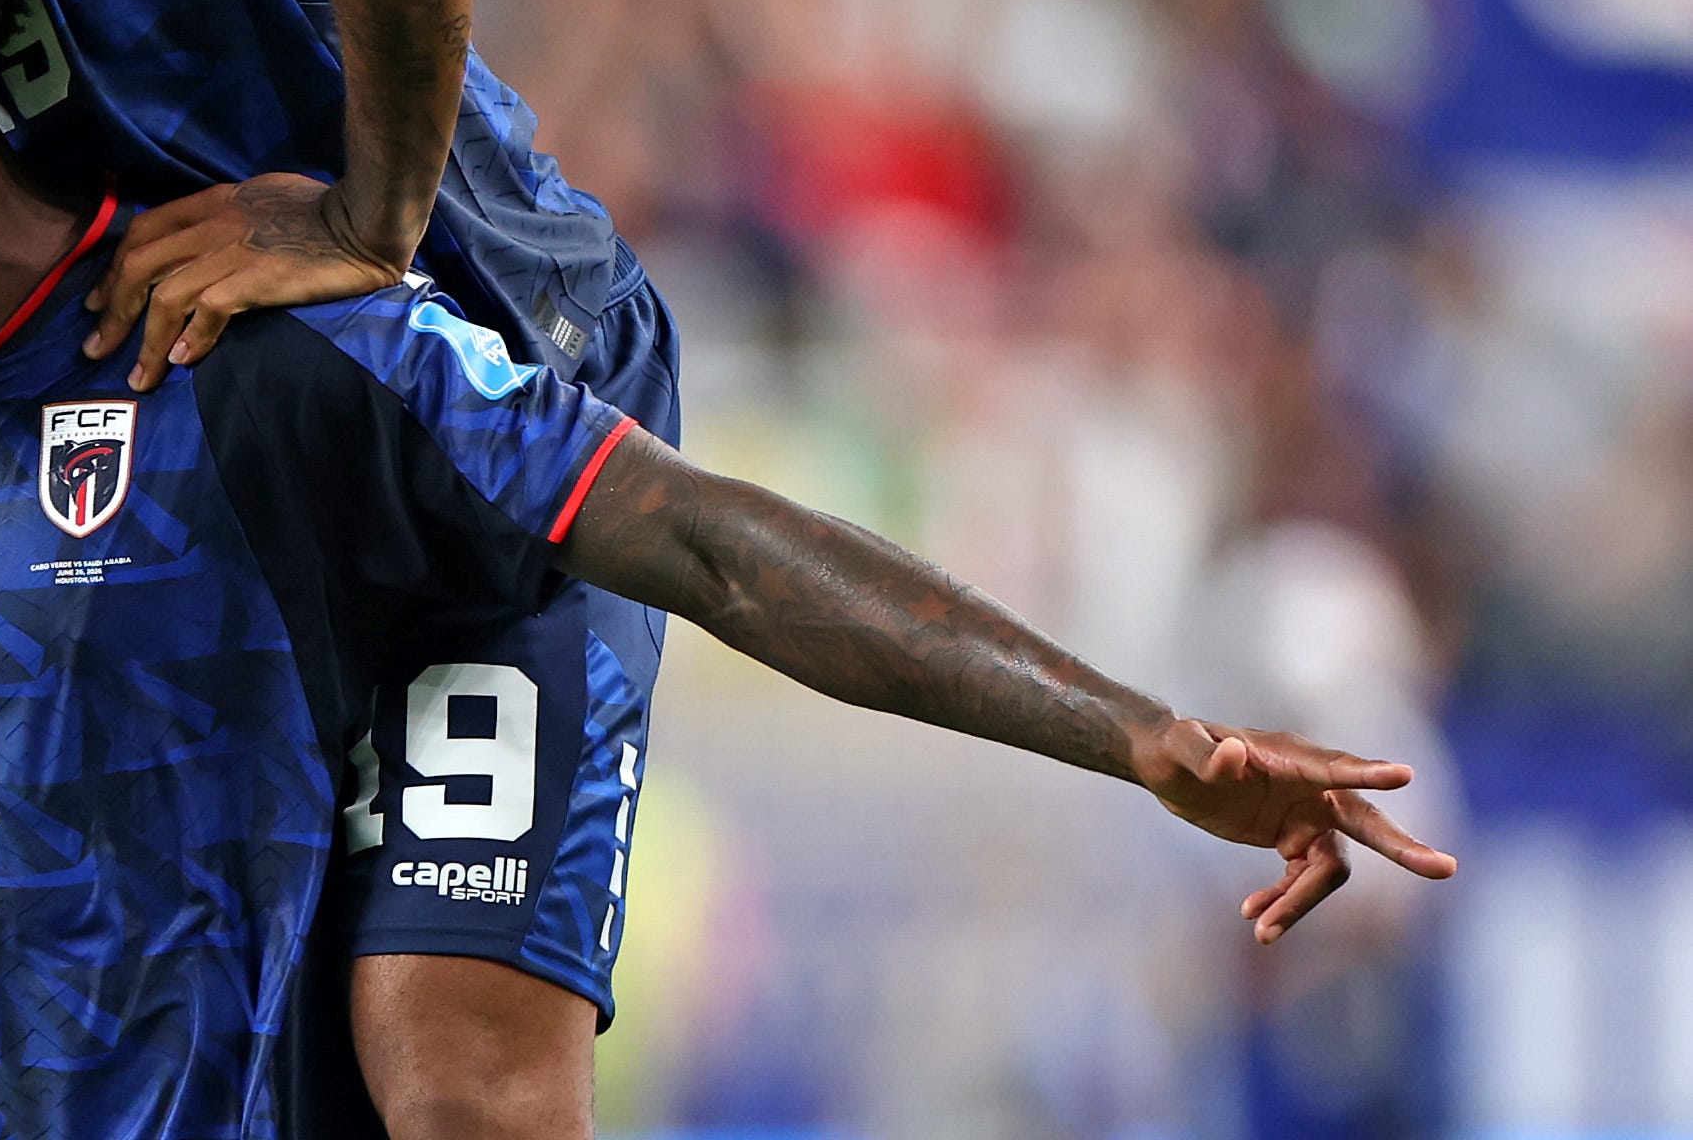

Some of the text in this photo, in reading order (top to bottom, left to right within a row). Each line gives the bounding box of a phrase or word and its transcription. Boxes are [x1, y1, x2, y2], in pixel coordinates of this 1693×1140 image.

[51, 409, 127, 431] FCF
[30, 563, 50, 571] CABO
[50, 561, 72, 569] VERDE
[104, 557, 132, 565] ARABIA
[392, 857, 528, 896] capelli
[451, 888, 525, 906] SPORT
